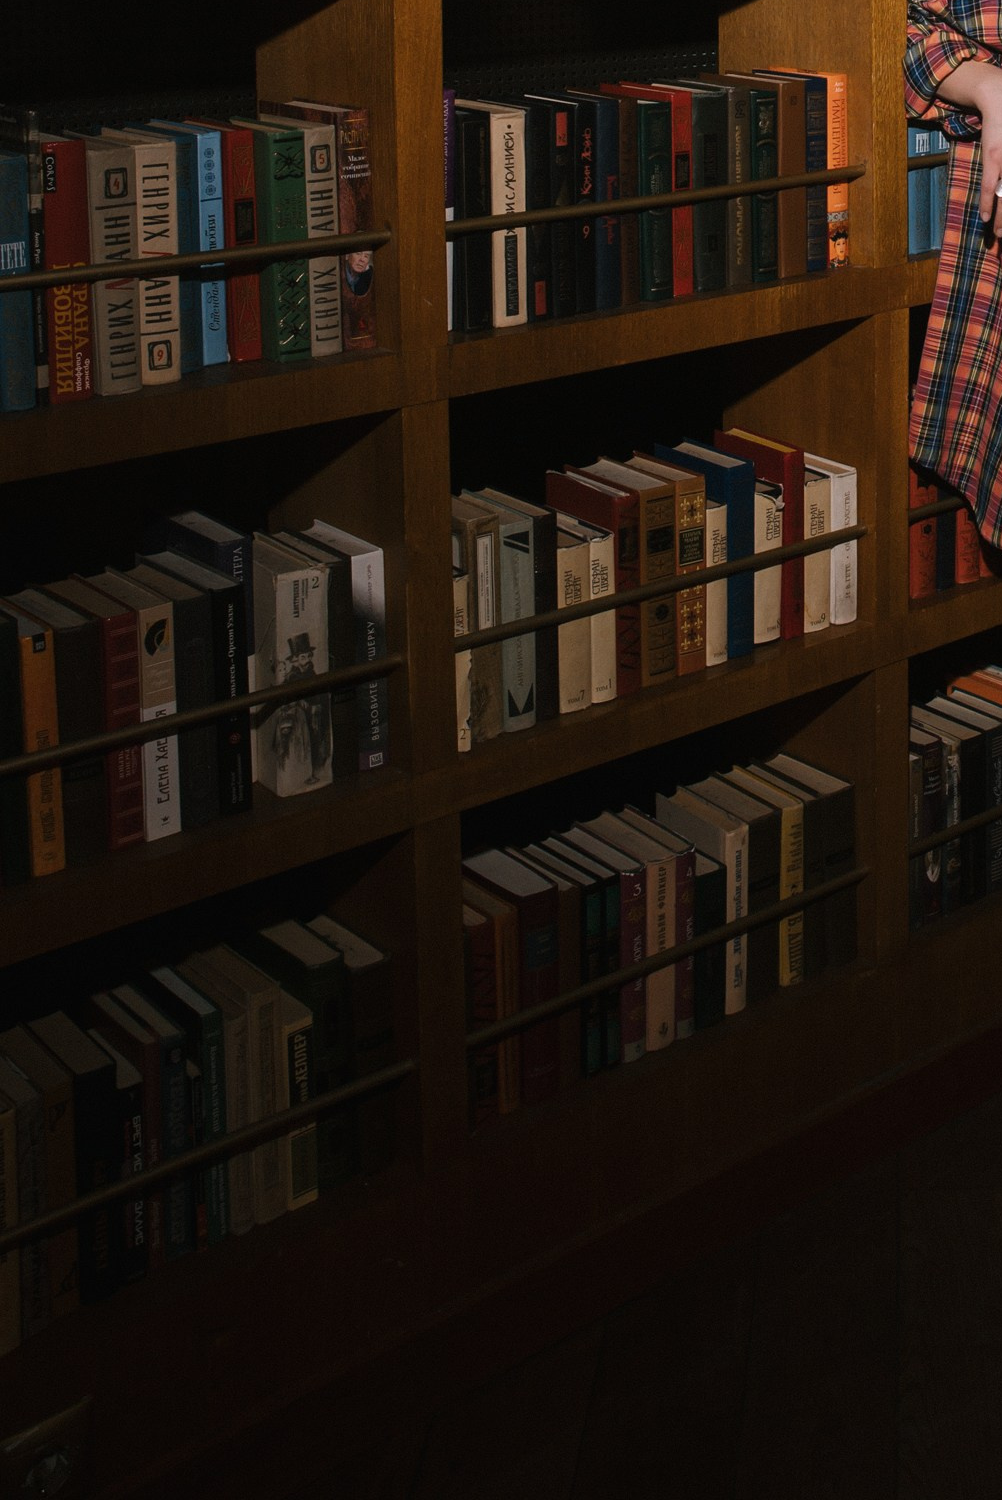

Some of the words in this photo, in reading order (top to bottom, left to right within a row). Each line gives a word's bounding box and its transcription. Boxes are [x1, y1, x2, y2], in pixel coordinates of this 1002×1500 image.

[318, 153, 326, 166] 5
[112, 179, 121, 191] 4
[141, 163, 170, 242] ГЕНРИХ
[33, 231, 41, 247] Анна
[313, 266, 339, 342] ГЕНРИХ
[107, 299, 138, 381] ГЕНРИХ
[156, 348, 165, 362] 9
[75, 351, 84, 392] Спаффорд
[83, 358, 92, 390] Фрэнсис
[766, 507, 774, 541] СТЕФАН
[773, 514, 781, 539] ЦВЕЙГ
[809, 503, 818, 537] СТЕФАН
[817, 509, 825, 535] ЦВЕЙГ
[711, 529, 721, 564] СТЕФАН
[311, 576, 319, 589] 2
[564, 570, 574, 606] СТЕФАН
[573, 576, 583, 603] ЦВЕЙГ
[591, 558, 602, 595] СТЕФАН
[600, 564, 610, 593] ЦВЕЙГ
[820, 612, 826, 622] 9
[579, 689, 586, 701] 7
[368, 682, 380, 741] ВЫЗОВИТЕ
[632, 882, 642, 898] 3
[657, 866, 668, 910] ФОЛКНЕР
[131, 1114, 143, 1147] БРЕТ
